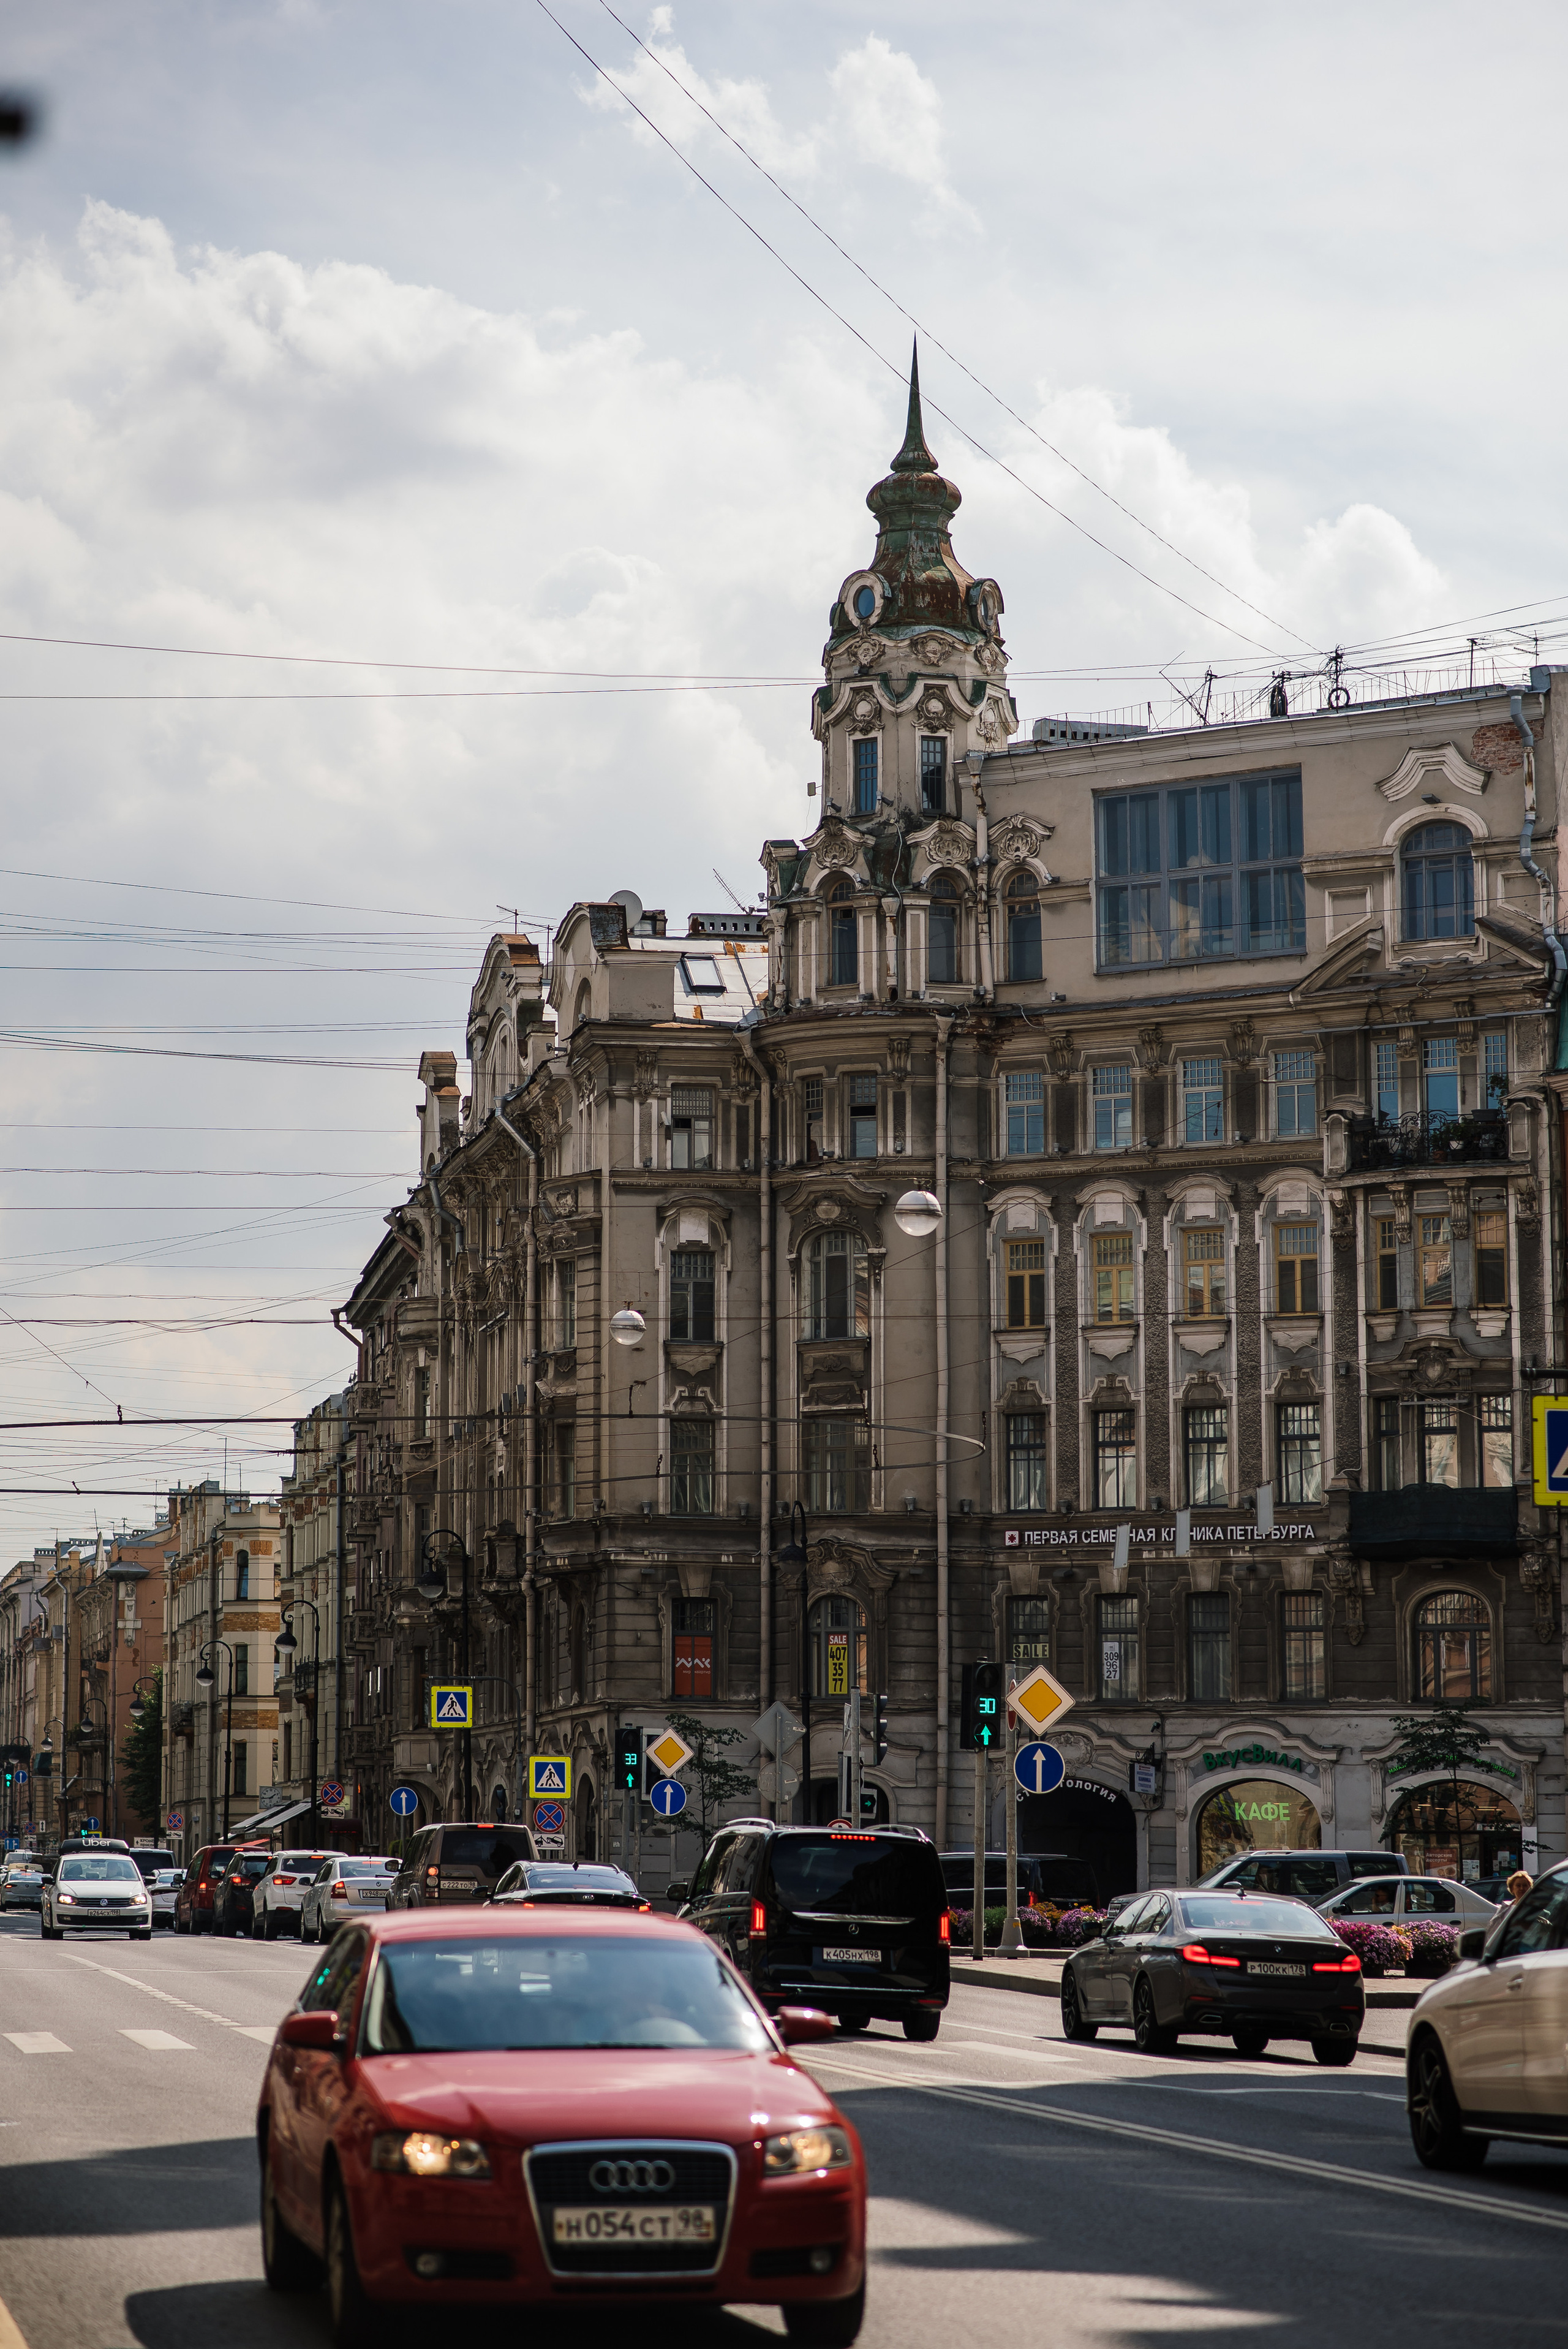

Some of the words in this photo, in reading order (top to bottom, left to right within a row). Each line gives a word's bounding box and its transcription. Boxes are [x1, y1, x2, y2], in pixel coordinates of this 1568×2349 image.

[1025, 1530, 1077, 1545] ПЕРВАЯ
[1082, 1528, 1155, 1543] СЕМЕНАЯ
[1162, 1526, 1224, 1541] КЛНИКА
[830, 1635, 846, 1644] SALE
[829, 1647, 846, 1661] 407
[1014, 1644, 1047, 1657] SALE
[1104, 1652, 1118, 1661] 309
[832, 1662, 843, 1676] 35
[1106, 1661, 1118, 1670] 96
[1106, 1670, 1118, 1679] 27
[832, 1678, 843, 1692] 77
[979, 1698, 995, 1713] 30
[625, 1753, 637, 1765] 33
[1202, 1744, 1302, 1772] ВкусВилл
[1016, 1779, 1117, 1802] СТТОЛОГИЯ
[1235, 1802, 1290, 1821] КАФЕ
